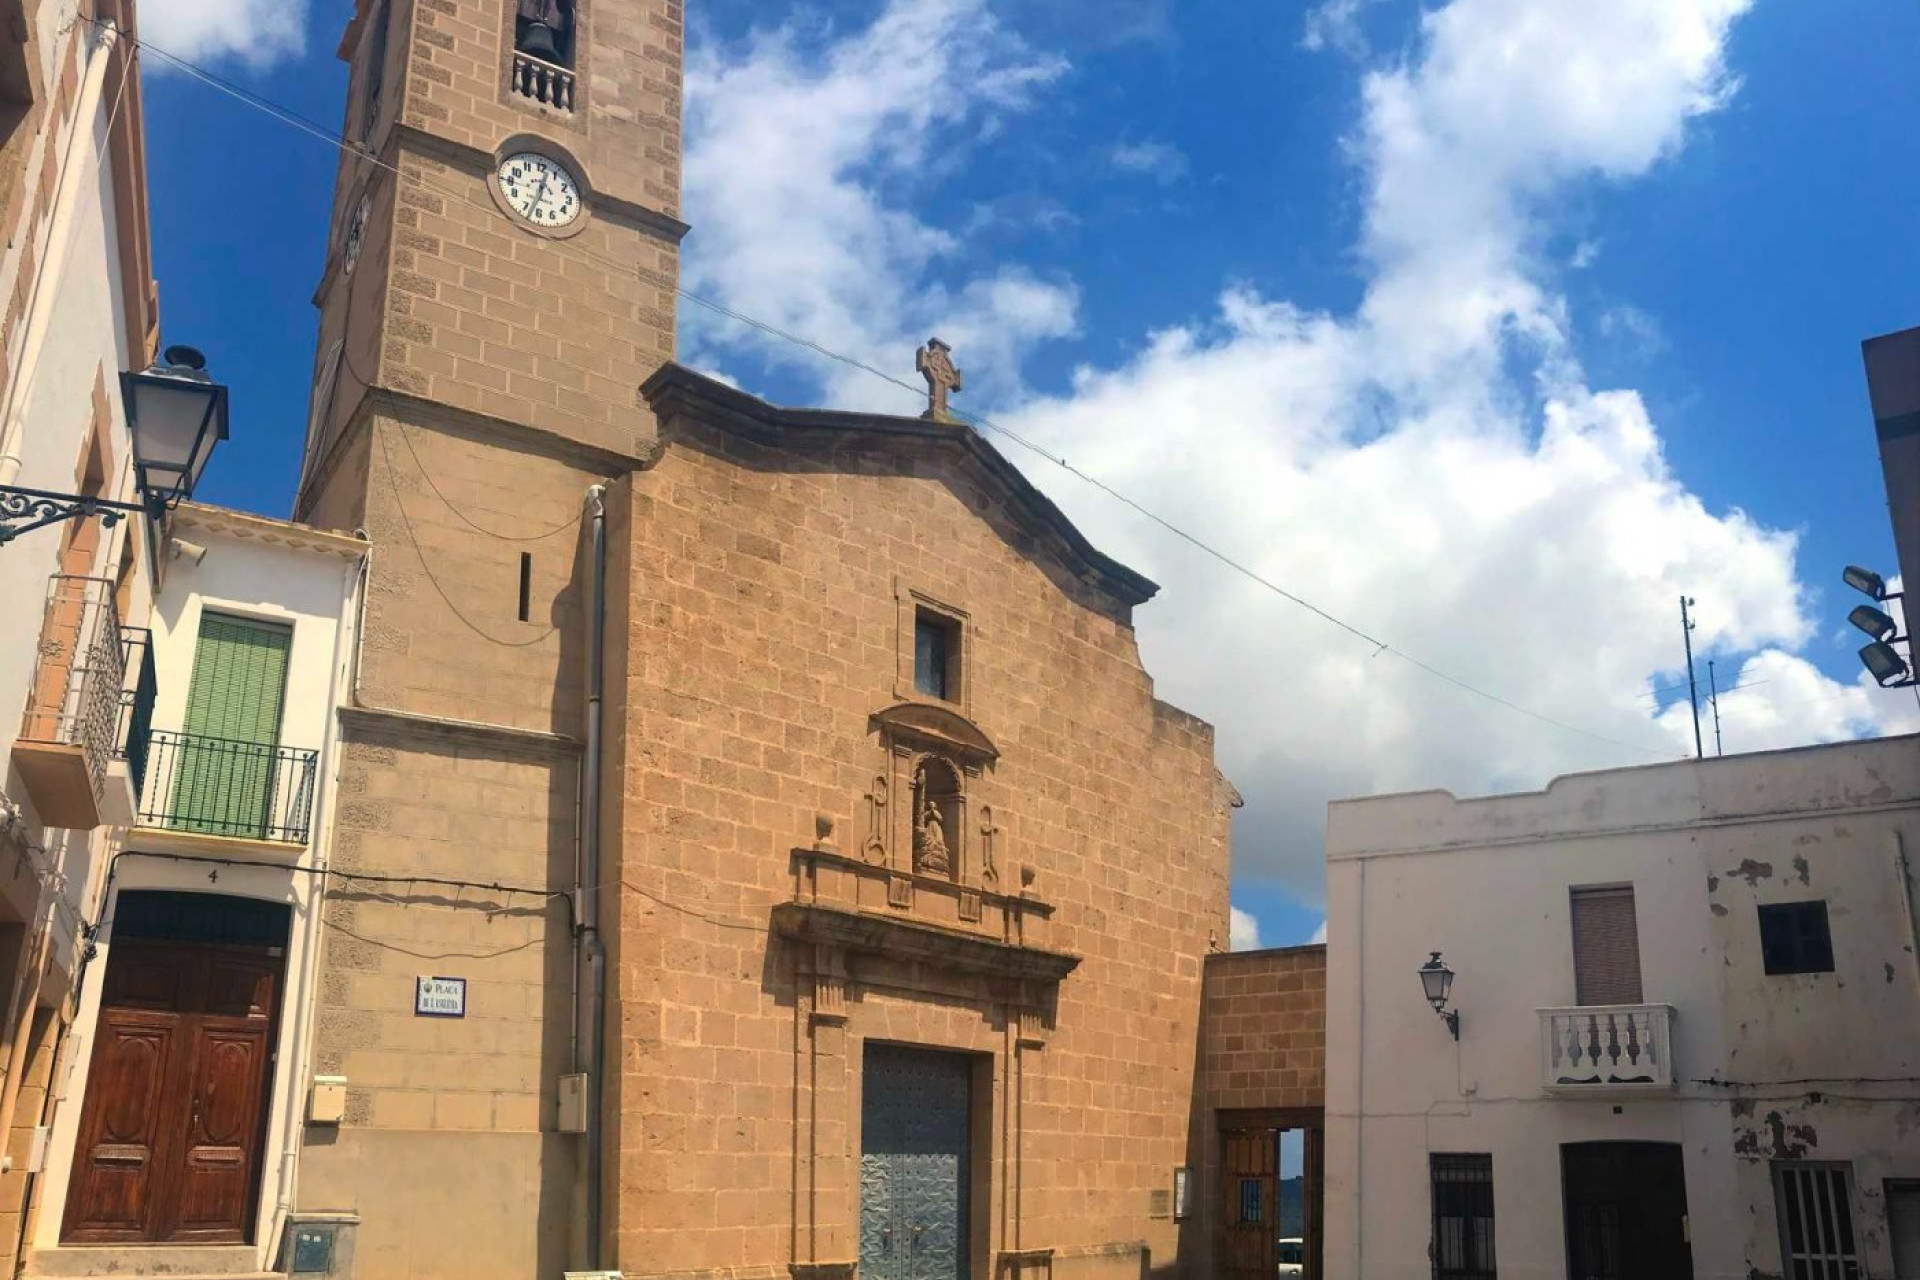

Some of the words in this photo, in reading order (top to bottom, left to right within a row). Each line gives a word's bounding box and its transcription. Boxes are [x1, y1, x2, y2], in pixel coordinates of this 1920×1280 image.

[523, 161, 531, 172] 11
[537, 162, 547, 173] 12
[512, 167, 522, 178] 10
[553, 171, 557, 180] 1
[561, 183, 568, 193] 2
[565, 195, 573, 205] 3
[523, 201, 529, 211] 7
[560, 205, 567, 215] 4
[208, 869, 219, 883] 4
